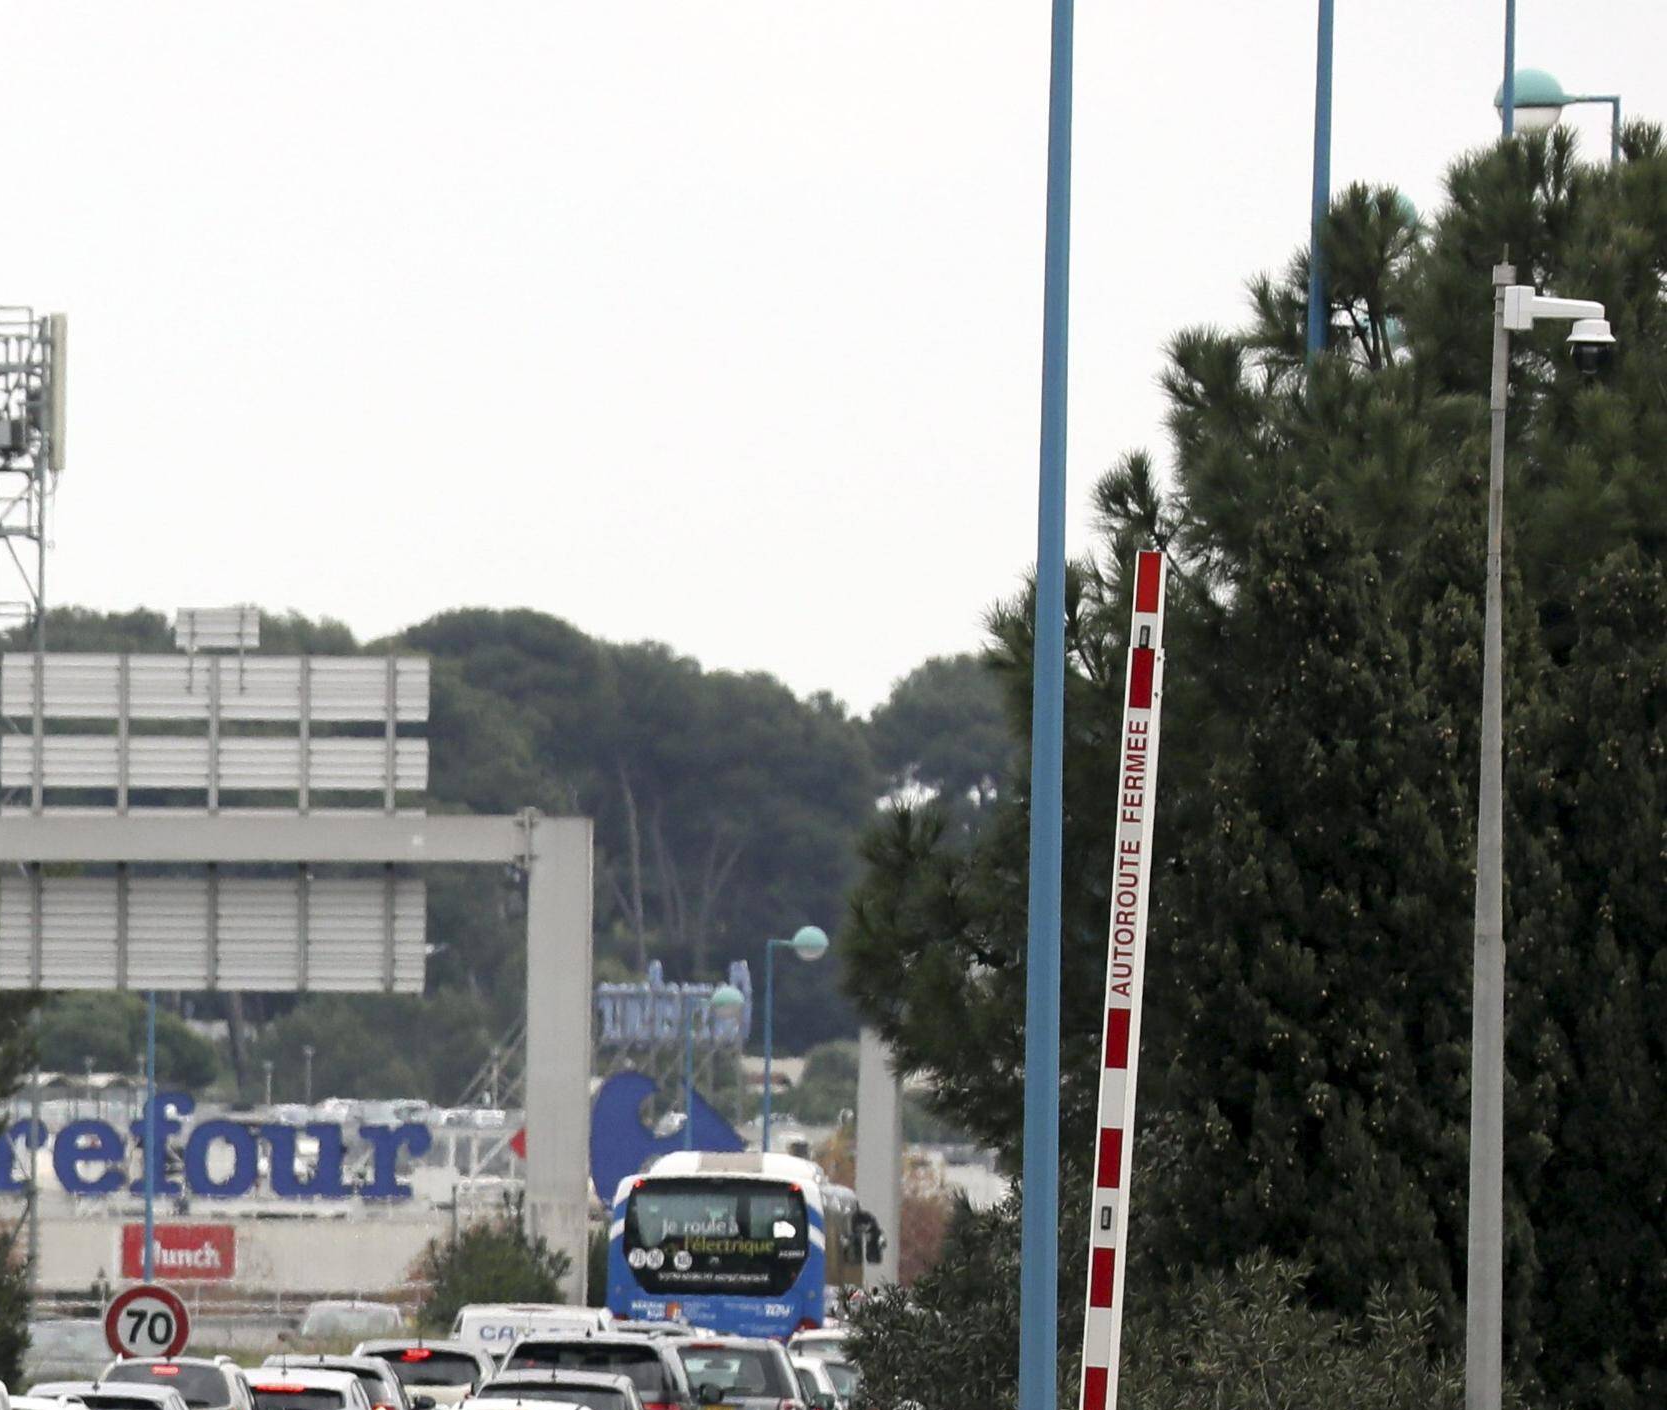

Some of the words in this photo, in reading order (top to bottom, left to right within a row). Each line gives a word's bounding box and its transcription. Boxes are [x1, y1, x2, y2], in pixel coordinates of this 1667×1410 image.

[1122, 720, 1148, 823] FERMEE
[1112, 840, 1140, 997] AUTOROUTE
[140, 1239, 220, 1267] lunch
[126, 1309, 173, 1345] 70
